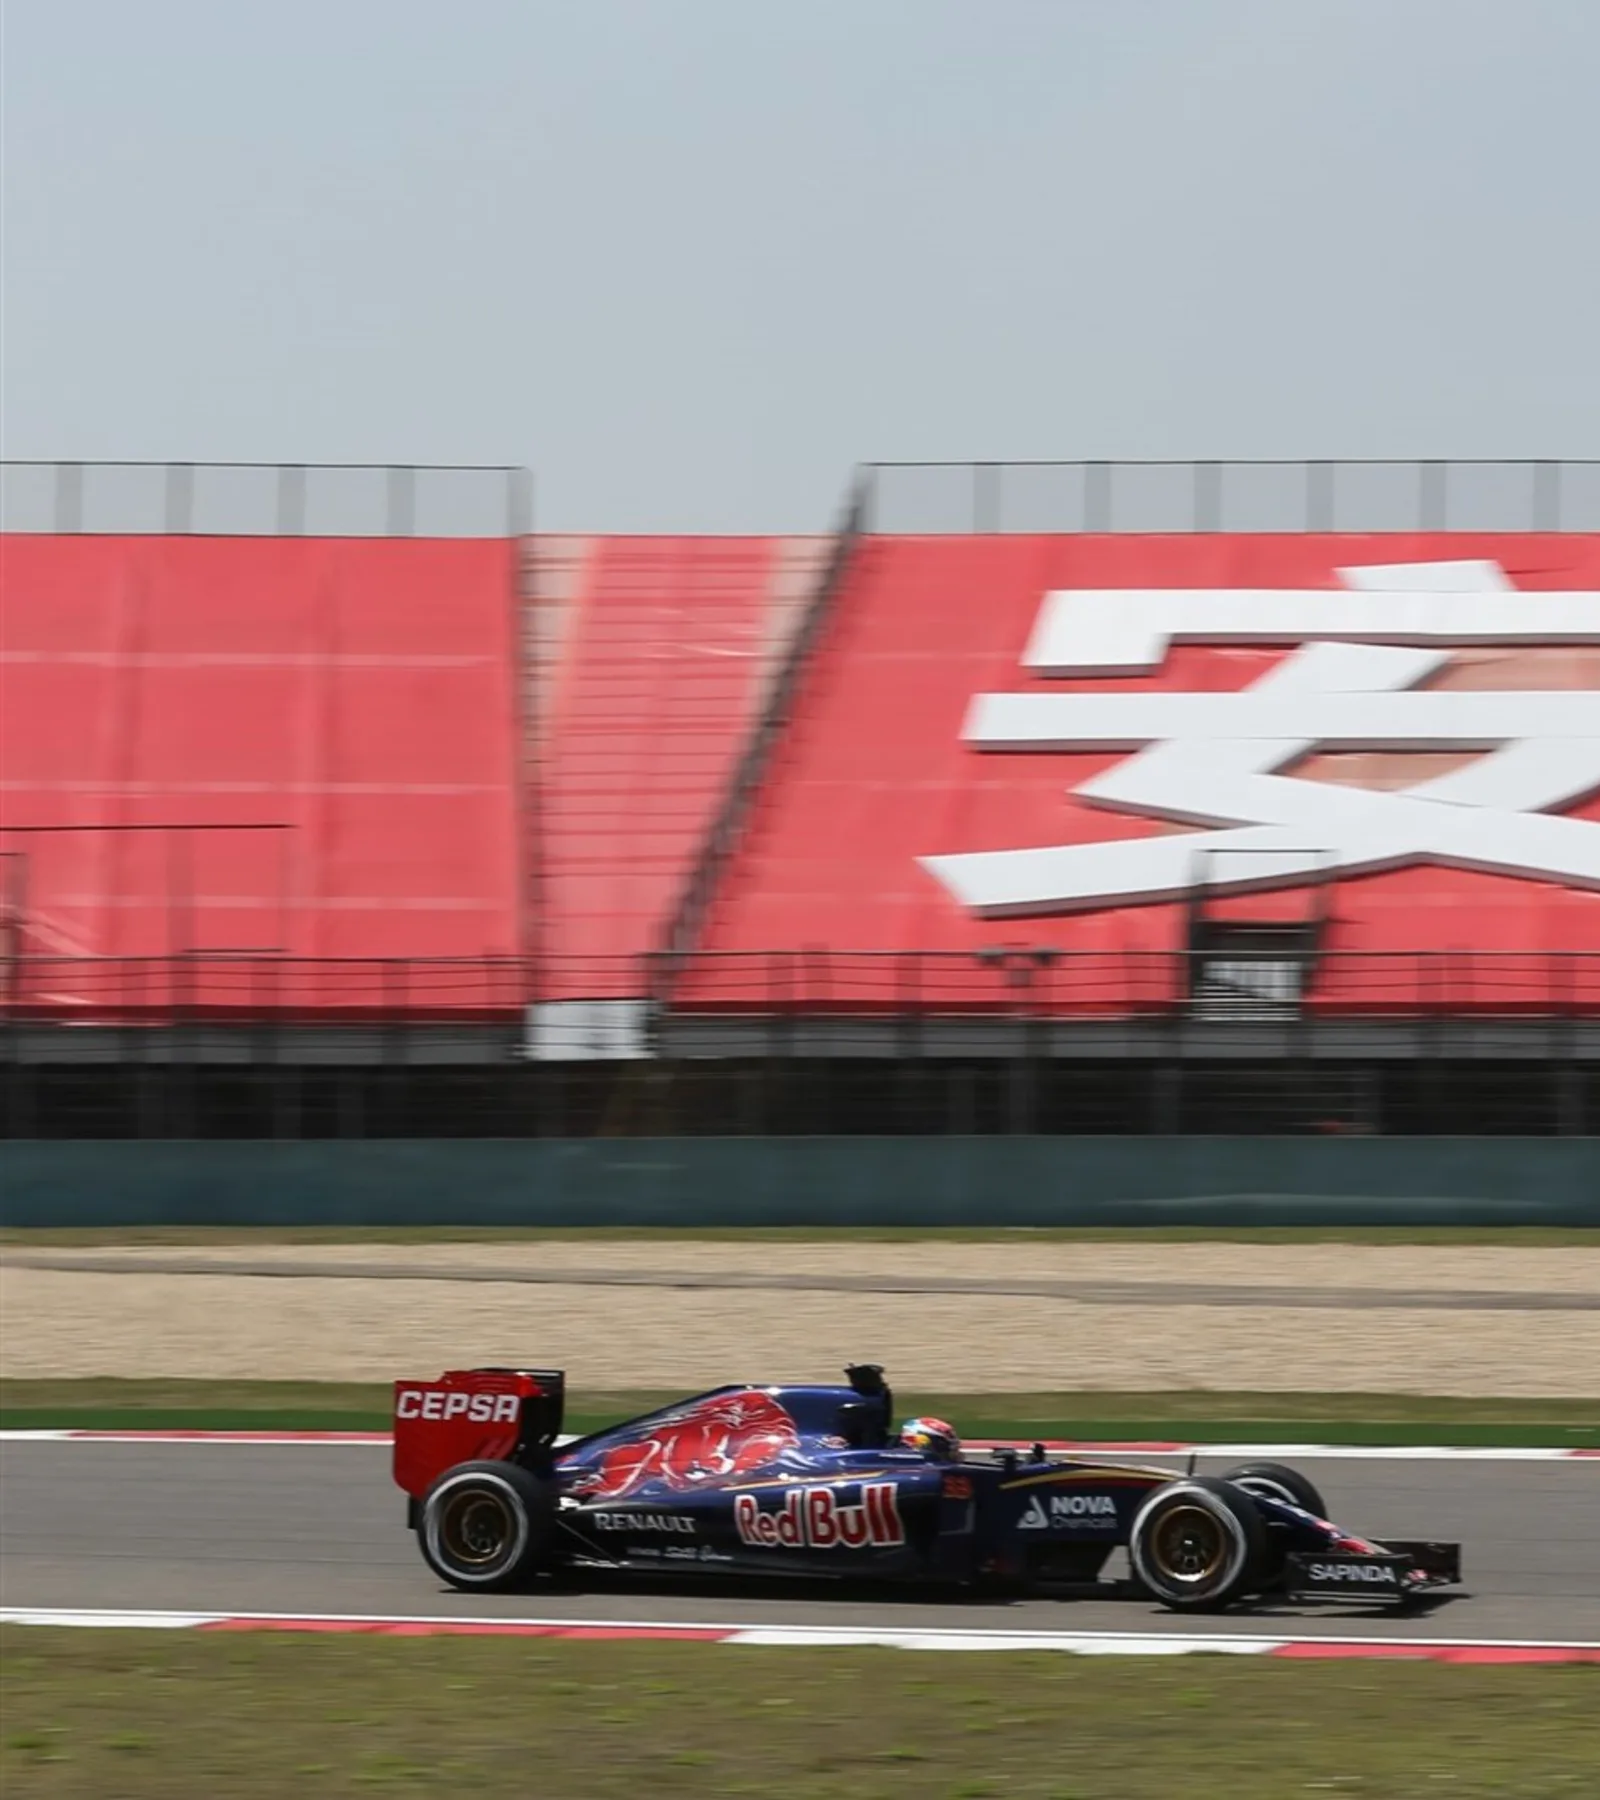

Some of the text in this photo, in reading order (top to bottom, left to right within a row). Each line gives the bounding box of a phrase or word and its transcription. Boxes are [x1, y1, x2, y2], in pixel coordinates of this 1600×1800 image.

[396, 1390, 520, 1422] CEPSA
[1051, 1496, 1117, 1514] NOVA
[593, 1513, 697, 1533] RENAULT
[734, 1483, 905, 1548] Red Bull
[1308, 1563, 1397, 1583] SAPINDA
